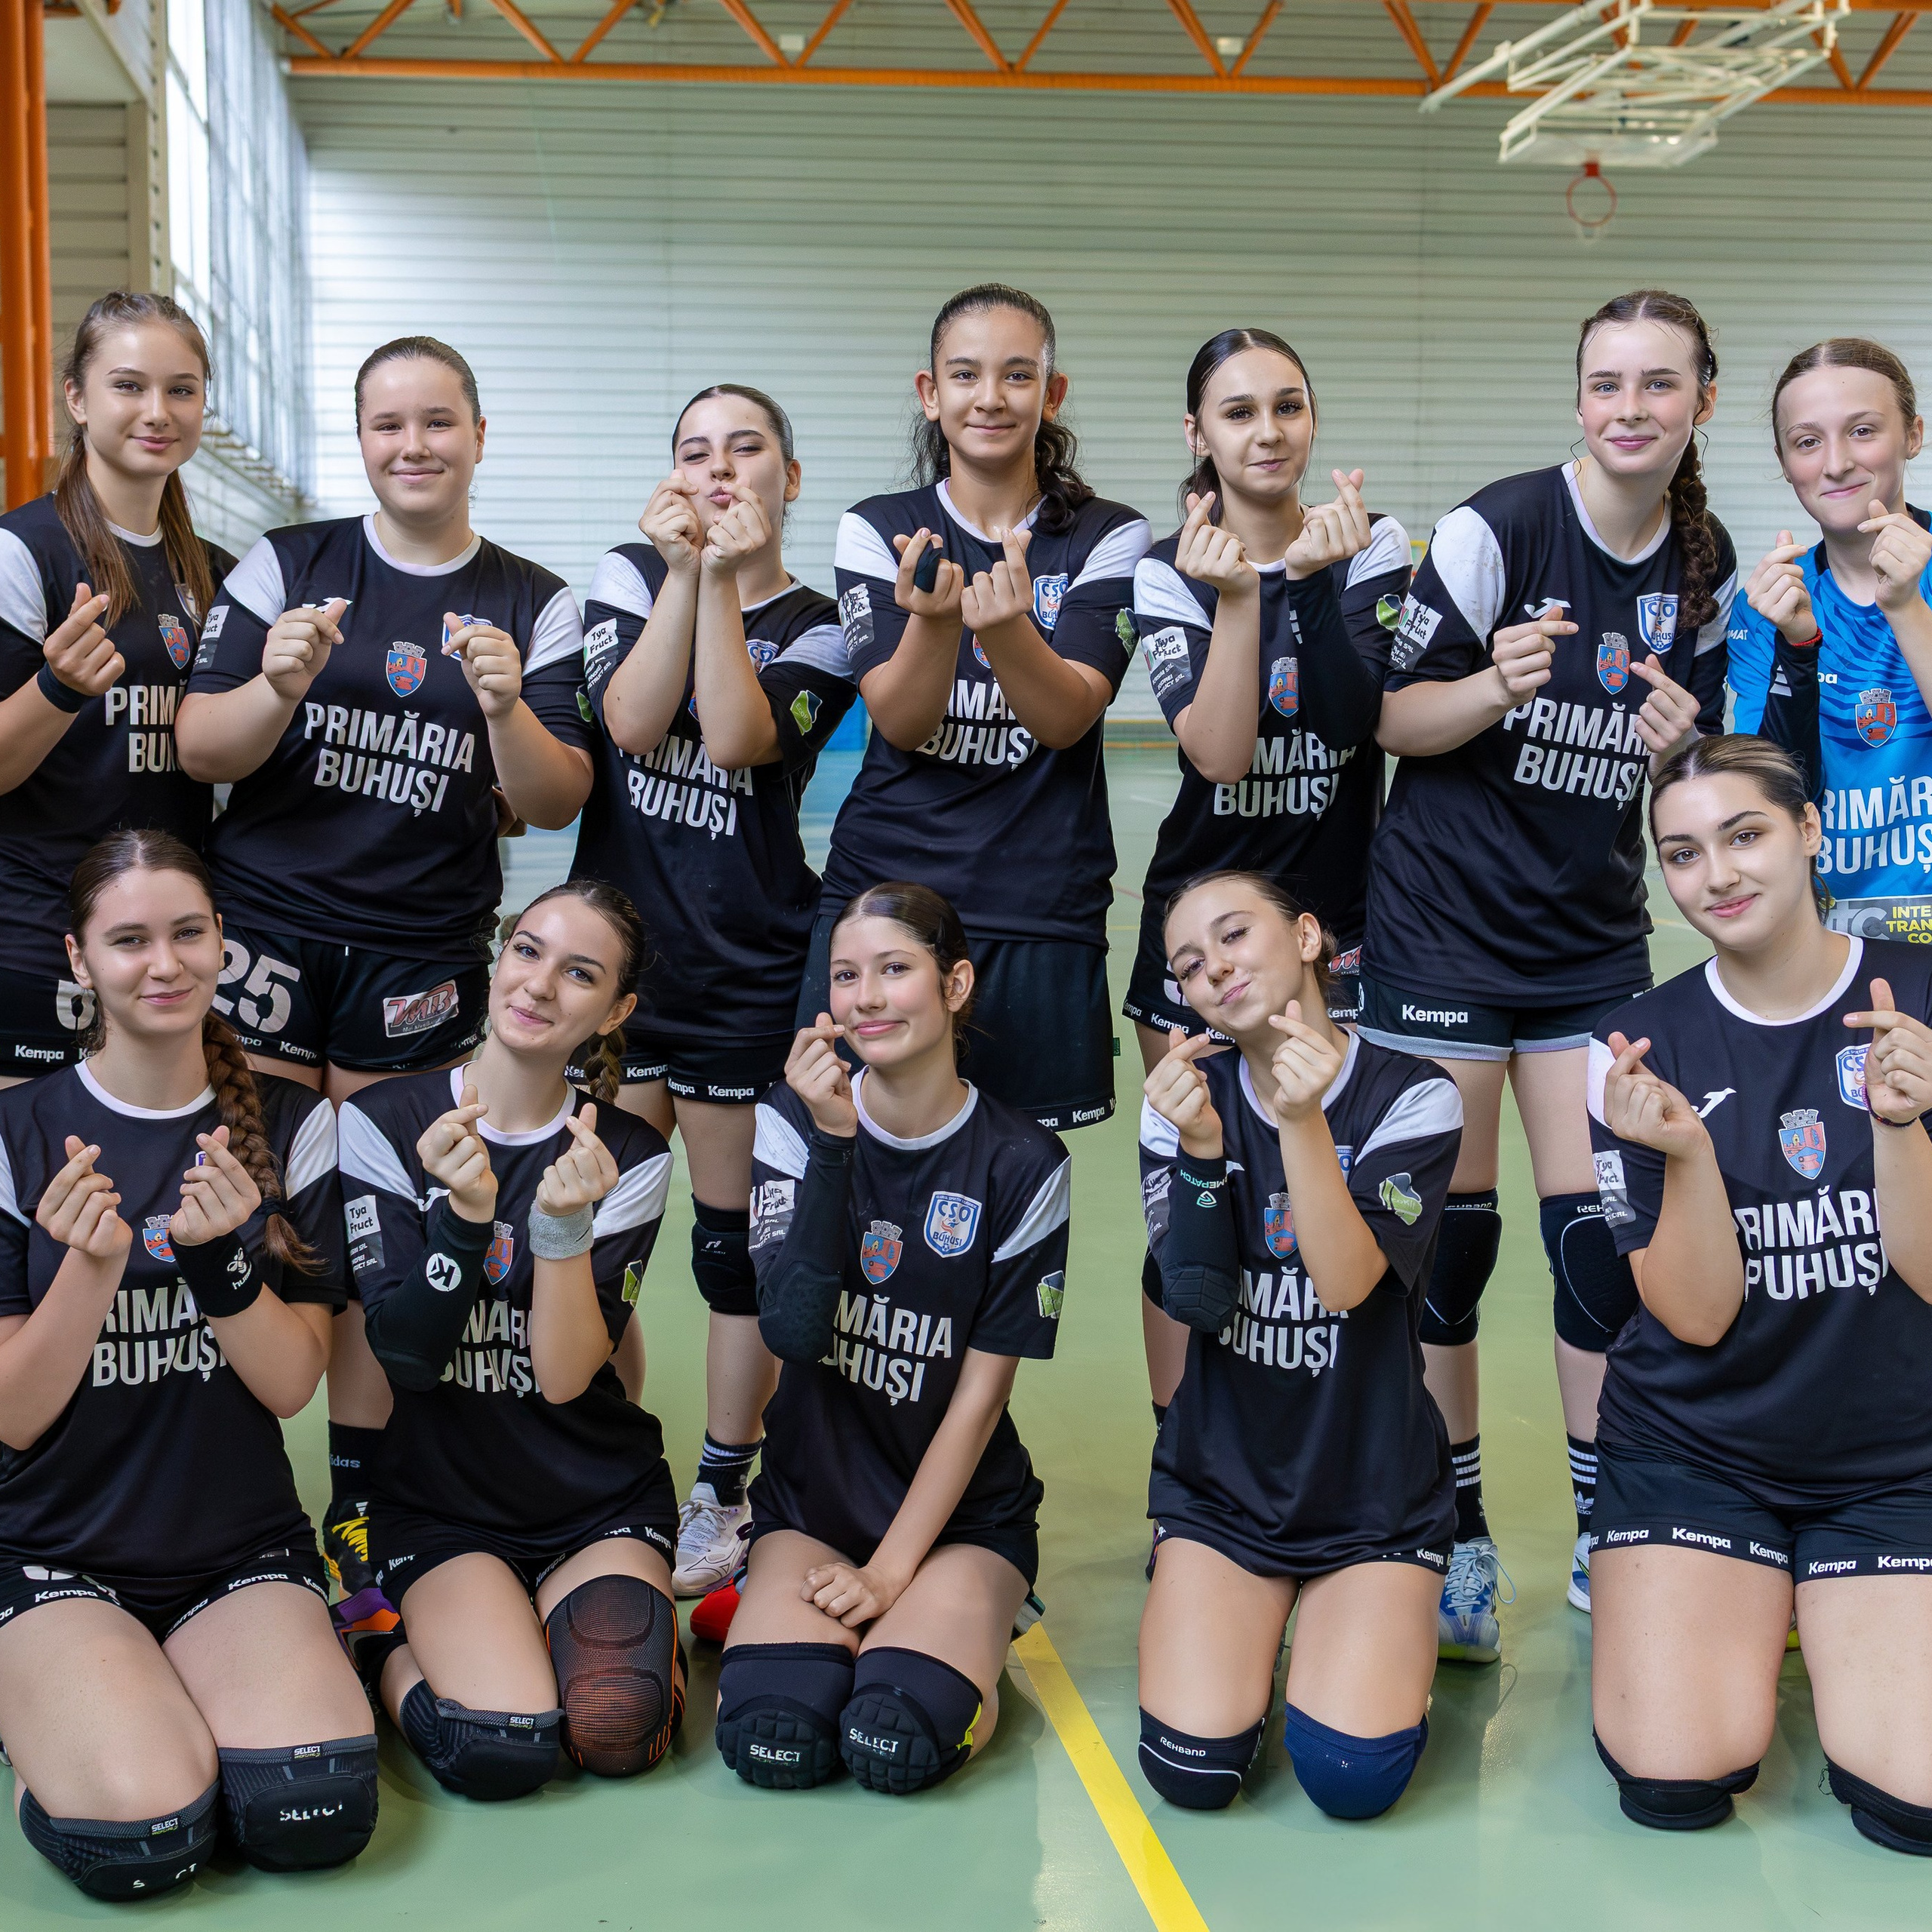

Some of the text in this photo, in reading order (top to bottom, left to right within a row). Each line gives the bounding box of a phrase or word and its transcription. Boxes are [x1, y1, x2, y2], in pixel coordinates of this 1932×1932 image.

[592, 627, 606, 641] Tya
[589, 635, 613, 654] Fruct
[304, 702, 475, 773] PRIMĂRIA
[314, 748, 450, 817] BUHUȘI
[1514, 743, 1644, 811] BUHUȘI
[628, 769, 737, 840] BUHUȘI
[1327, 1008, 1358, 1020] Kemp
[1402, 1004, 1469, 1027] Kempa
[15, 1044, 64, 1063] Kempa
[1843, 1056, 1865, 1072] CS
[708, 1084, 754, 1100] Kempa
[1072, 1106, 1105, 1123] Kempa
[1180, 1169, 1228, 1189] MEPATCH
[349, 1206, 367, 1219] Tya
[938, 1201, 971, 1222] CSO
[1734, 1184, 1881, 1251] RIMĂR
[350, 1217, 374, 1234] Fruct
[818, 1332, 925, 1407] UHUȘI
[330, 1454, 361, 1469] idas
[1607, 1529, 1649, 1543] Kempa
[1672, 1527, 1731, 1549] Kempa
[1749, 1542, 1789, 1564] Kempa
[1417, 1548, 1444, 1567] Kempa
[1808, 1555, 1932, 1575] Kempa Kemp
[229, 1572, 288, 1590] Kempa
[35, 1589, 98, 1603] Kempa
[510, 1716, 534, 1725] SELECT
[849, 1727, 899, 1753] SELECT
[294, 1746, 321, 1755] SELECT
[750, 1744, 801, 1762] SELECT
[152, 1818, 178, 1833] SELECT
